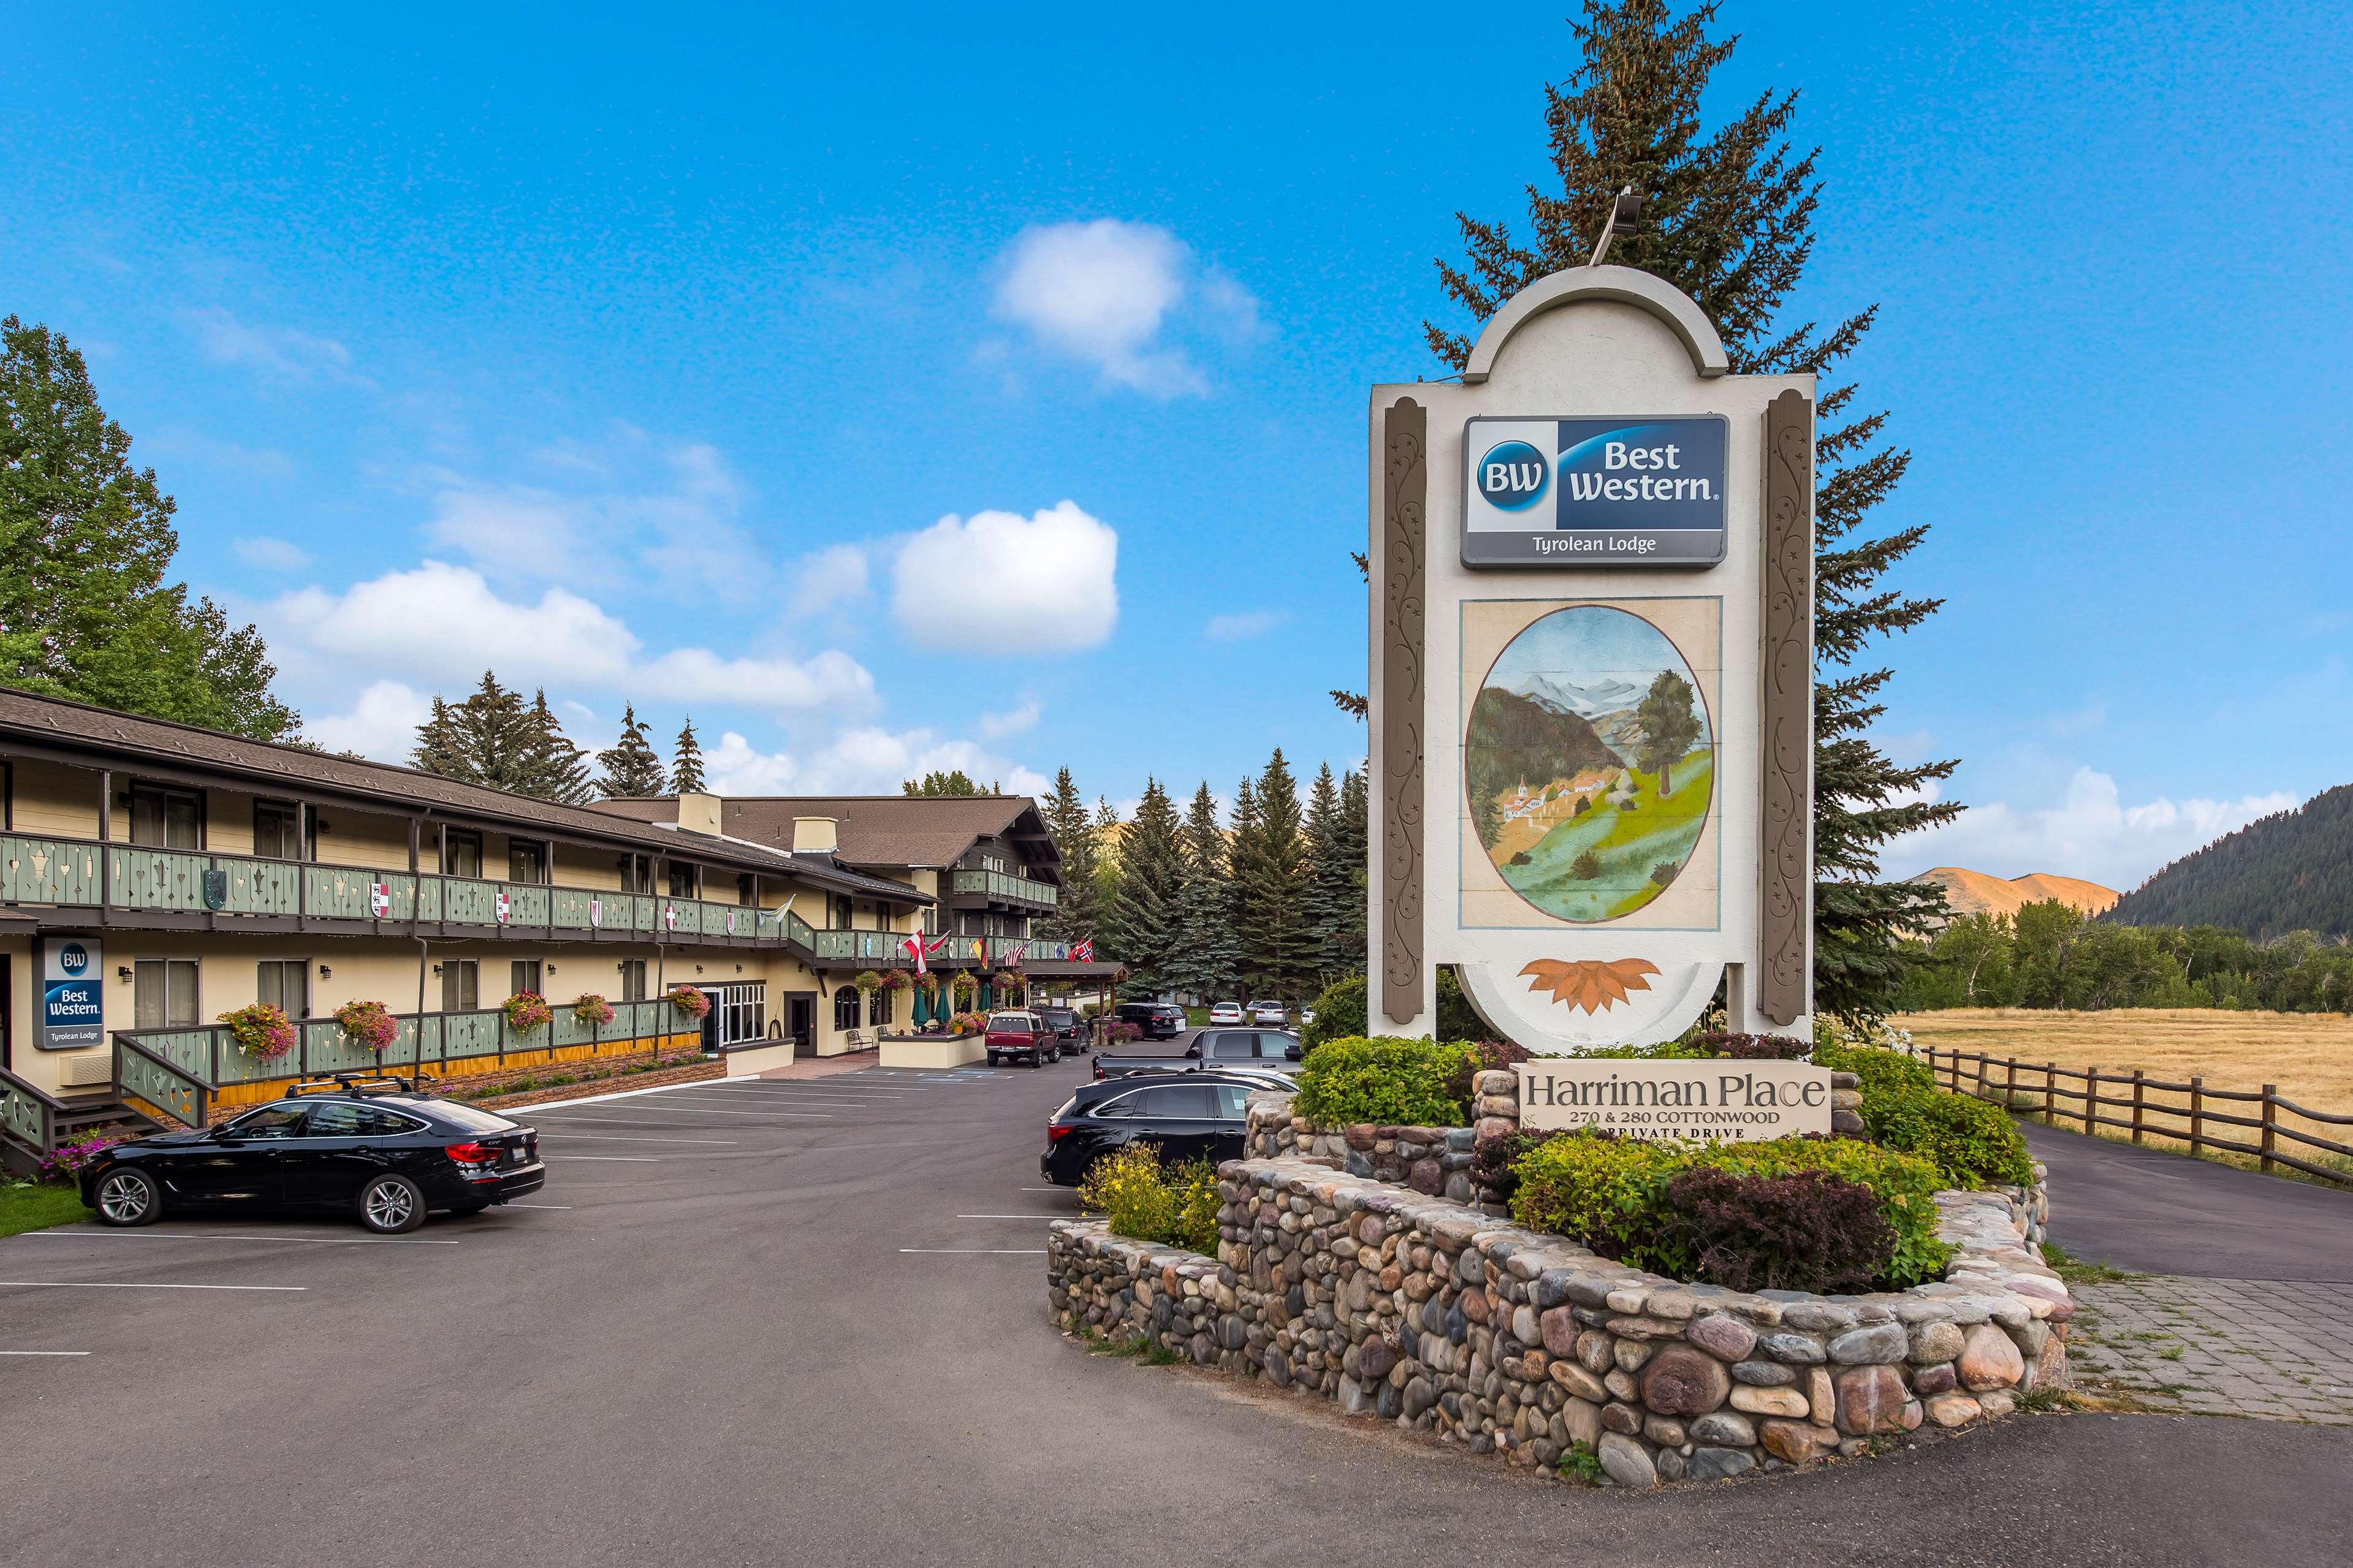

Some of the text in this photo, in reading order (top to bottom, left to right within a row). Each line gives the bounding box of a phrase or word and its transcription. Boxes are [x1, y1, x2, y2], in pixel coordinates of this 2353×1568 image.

[1605, 442, 1681, 470] Best
[1486, 463, 1542, 492] BW
[1532, 536, 1657, 555] Tyrolean Lodge
[63, 953, 85, 967] BW
[62, 990, 88, 1002] Best
[51, 1031, 97, 1042] Tyrolean Lodge
[1526, 1073, 1825, 1107] Harriman Place
[1570, 1112, 1781, 1124] 270 & 280 COTTONWOOD
[1690, 1128, 1744, 1138] DRIVE
